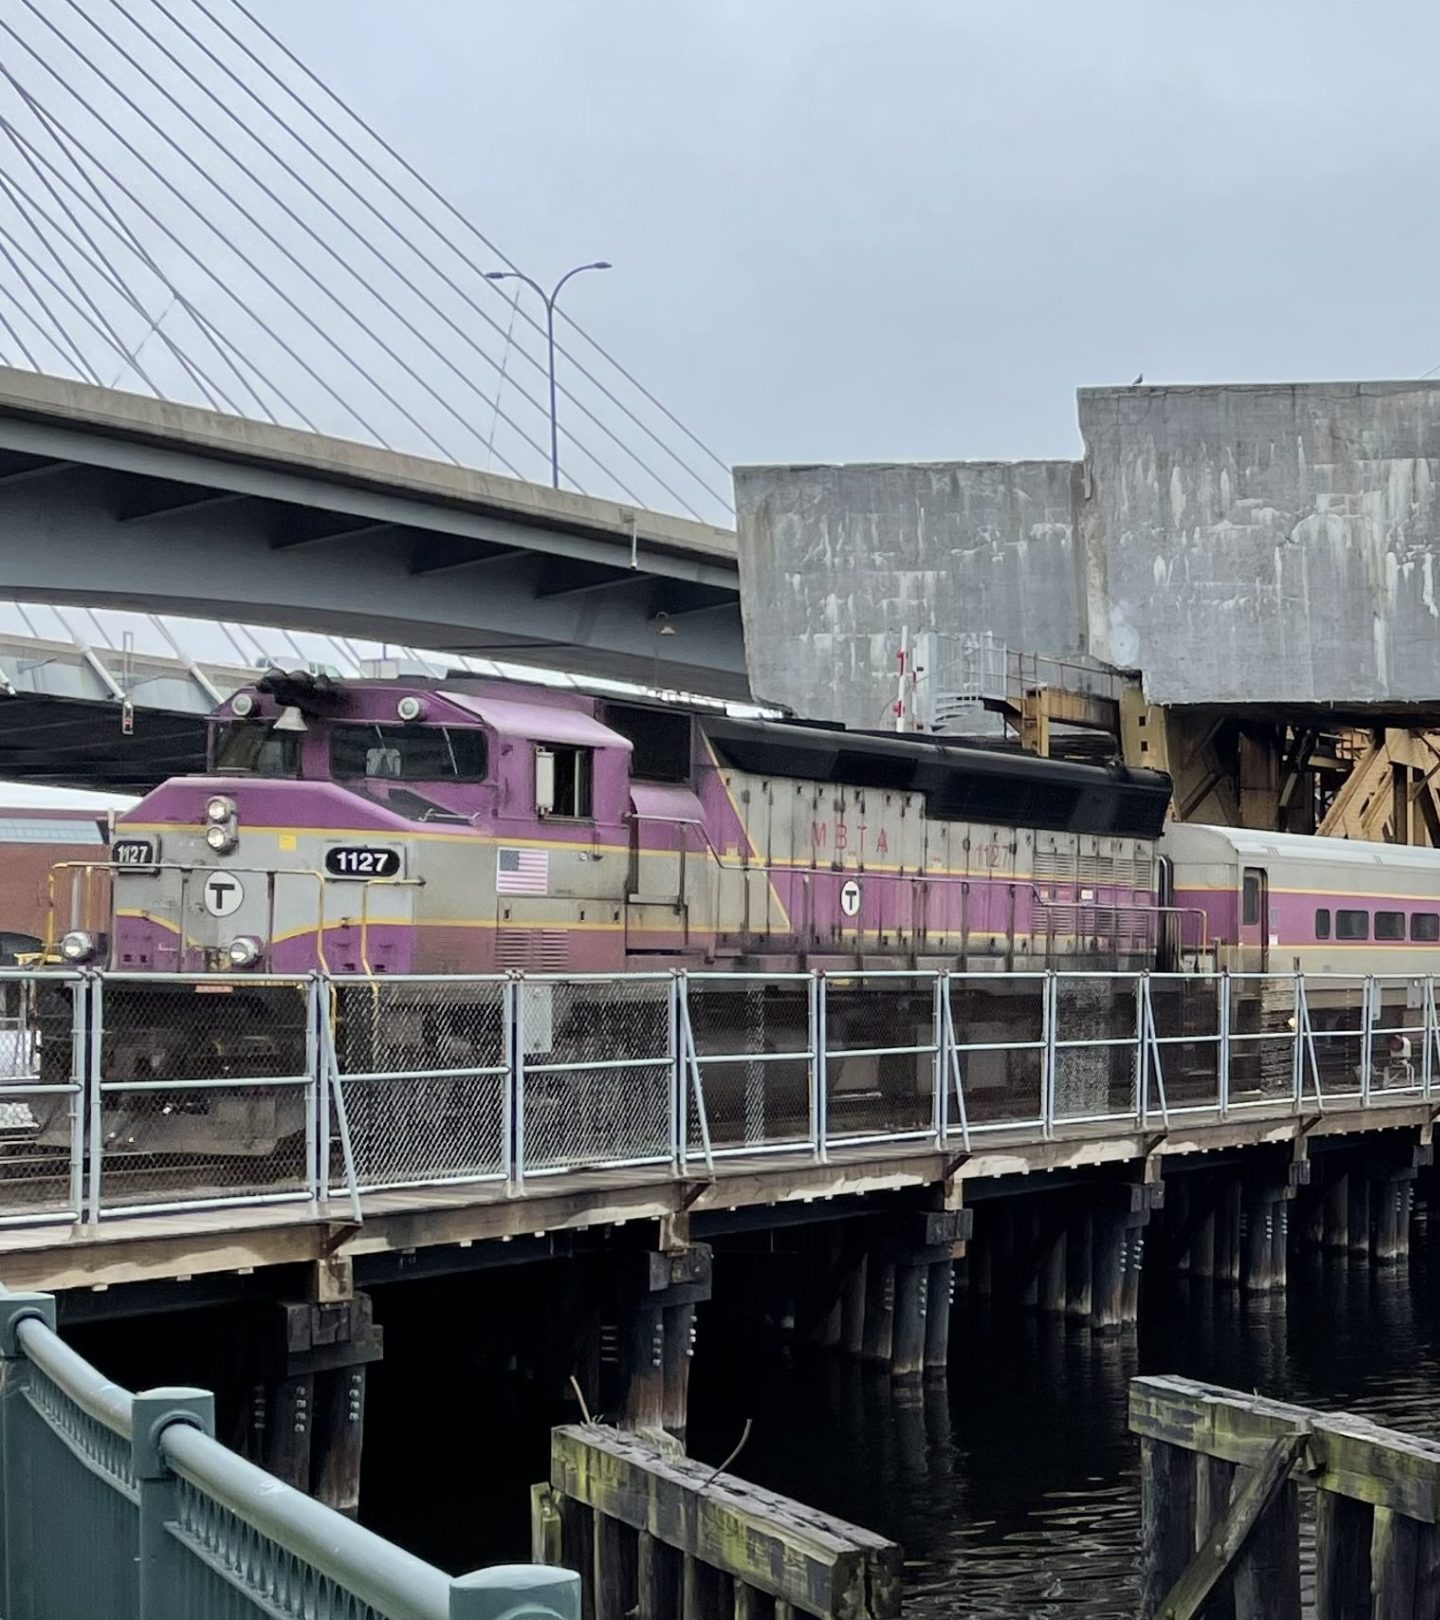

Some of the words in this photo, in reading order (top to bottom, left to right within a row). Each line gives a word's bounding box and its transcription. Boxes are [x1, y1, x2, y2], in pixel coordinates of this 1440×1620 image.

[117, 845, 148, 863] 1127
[336, 852, 389, 872] 1127
[210, 883, 235, 909] T
[845, 890, 857, 910] T
